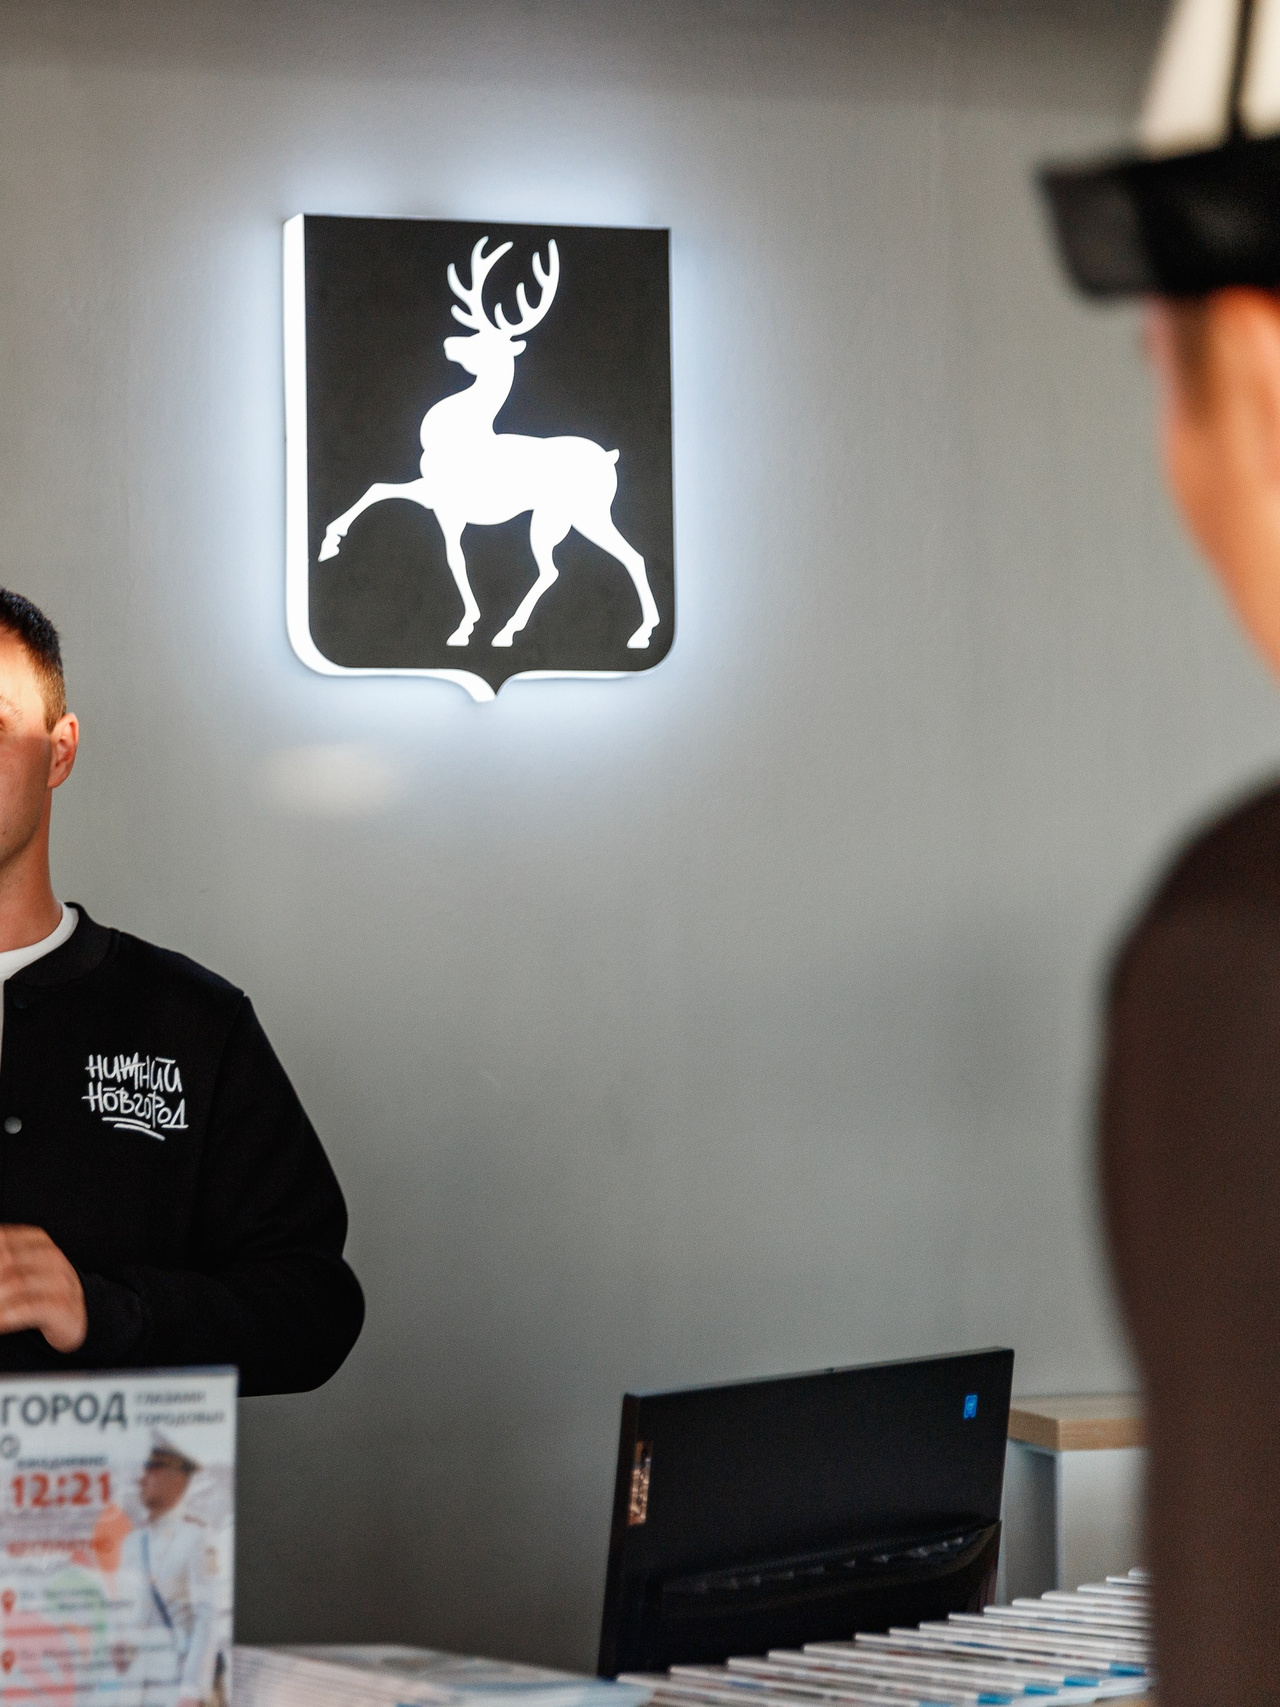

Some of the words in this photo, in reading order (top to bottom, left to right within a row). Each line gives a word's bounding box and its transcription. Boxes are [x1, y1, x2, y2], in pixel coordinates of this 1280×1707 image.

[85, 1052, 183, 1093] НИЖНИЙ
[0, 1391, 127, 1431] ГОРОД
[11, 1472, 111, 1508] 12:21
